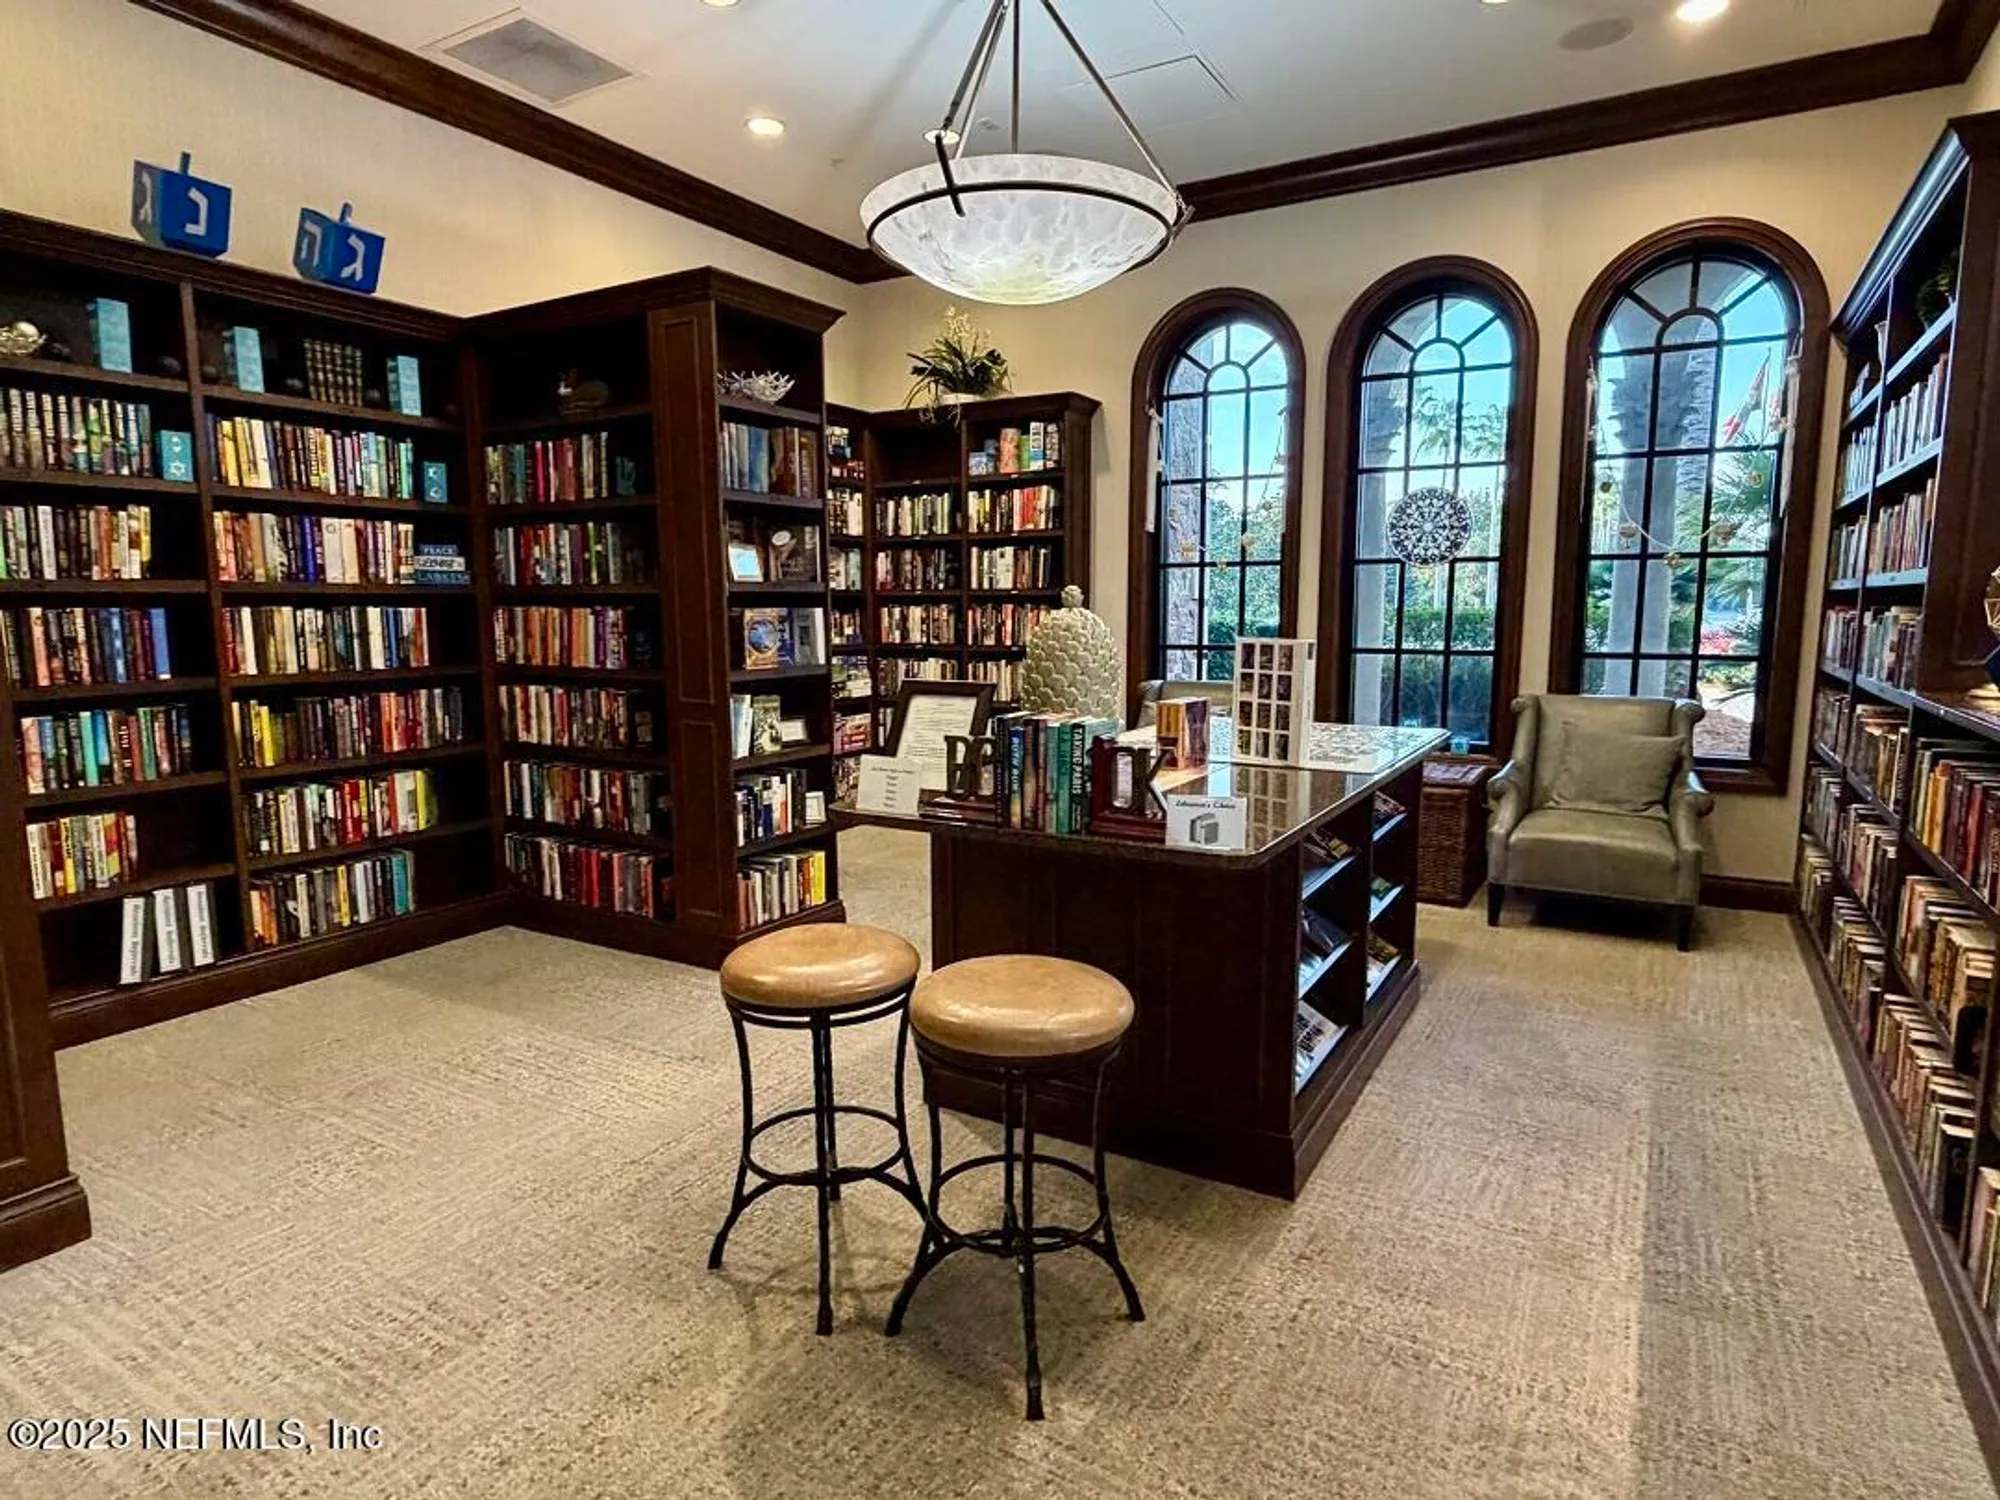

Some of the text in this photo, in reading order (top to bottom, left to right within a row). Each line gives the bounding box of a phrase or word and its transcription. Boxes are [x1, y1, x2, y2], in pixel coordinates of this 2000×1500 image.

[340, 233, 365, 282] ג
[1072, 727, 1083, 764] TAKING
[1071, 764, 1082, 794] PARIS
